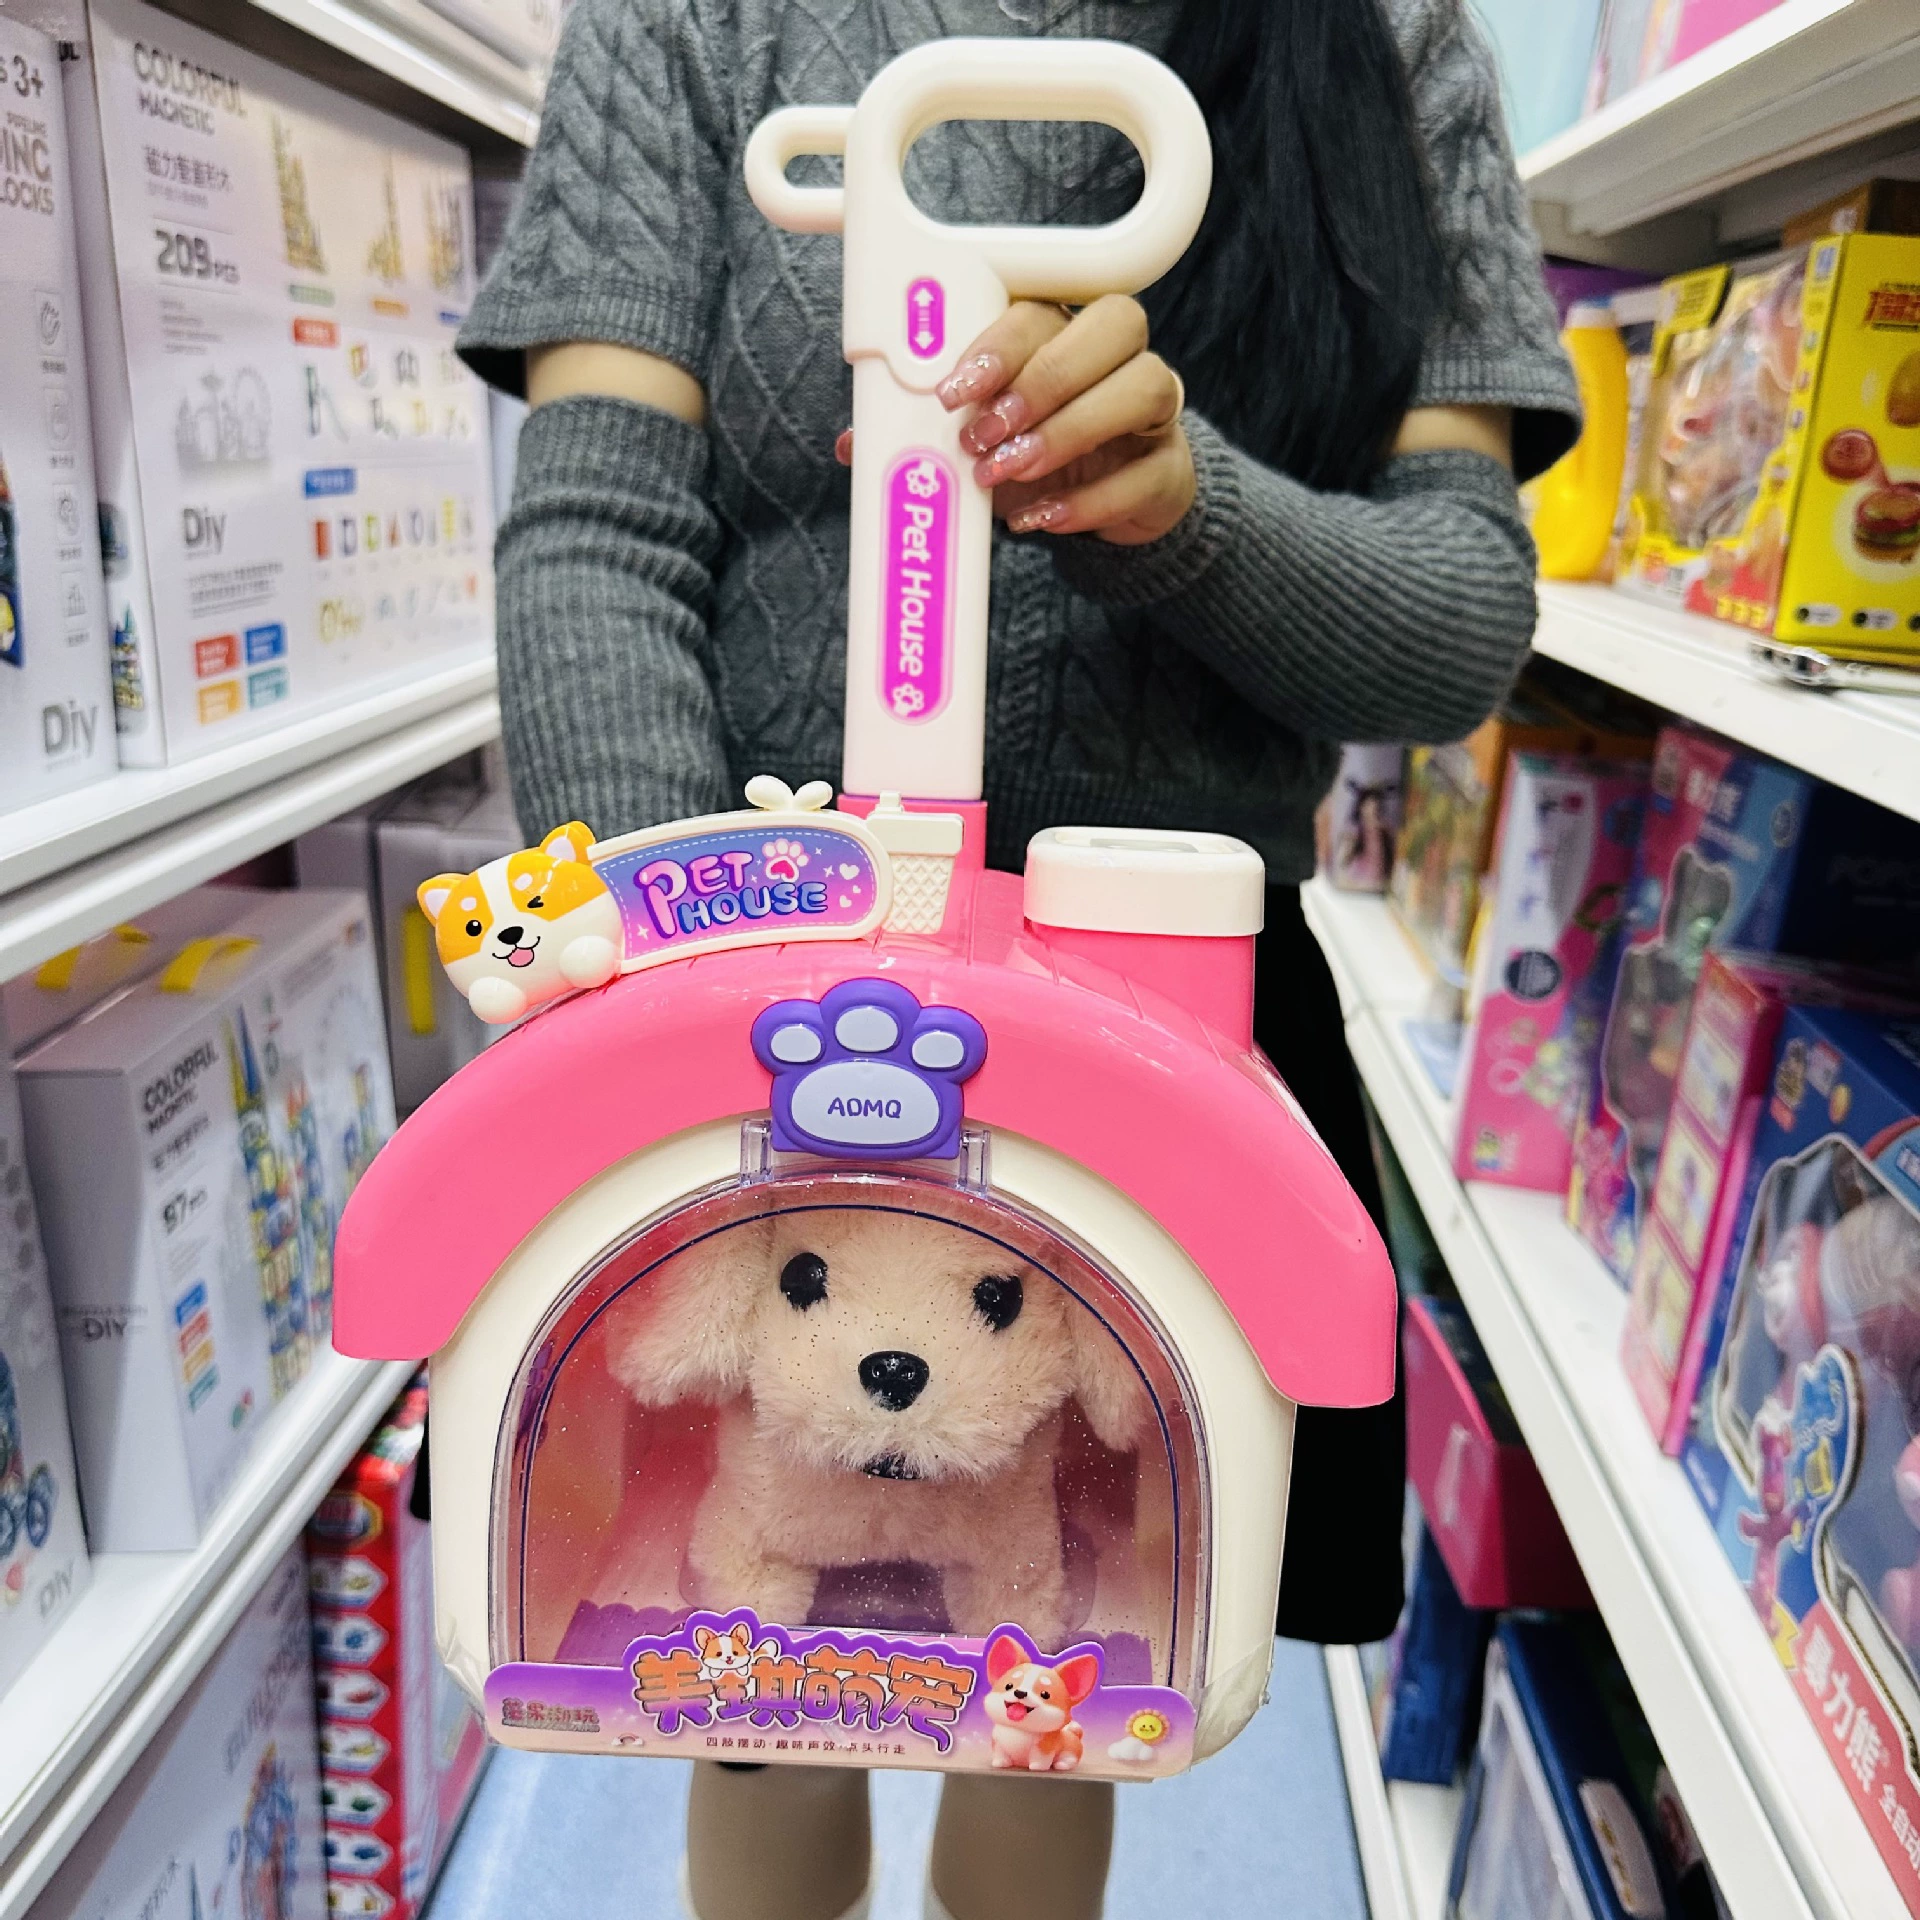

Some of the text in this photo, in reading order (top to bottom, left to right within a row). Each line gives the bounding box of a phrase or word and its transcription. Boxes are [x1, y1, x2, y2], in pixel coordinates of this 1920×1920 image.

[14, 55, 43, 97] 3+
[184, 506, 227, 554] Diy
[900, 503, 935, 678] Pet House
[43, 698, 98, 756] Diy
[634, 851, 754, 939] PET
[677, 881, 828, 934] HOUSE
[827, 1096, 902, 1119] ADMQ
[632, 1645, 975, 1753] 美琪萌宠
[1802, 1623, 1884, 1794] 暴力熊
